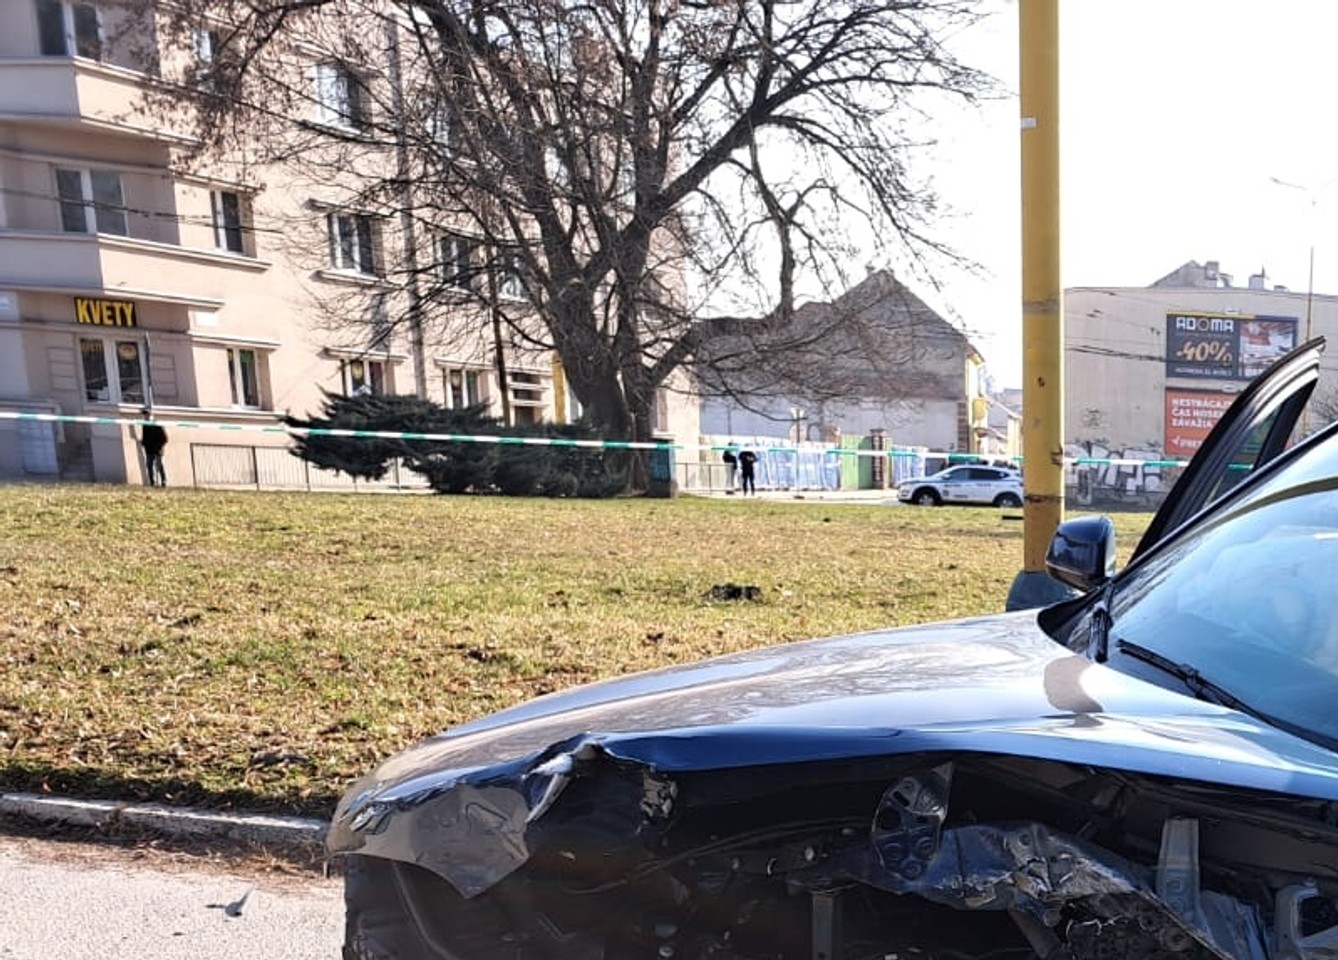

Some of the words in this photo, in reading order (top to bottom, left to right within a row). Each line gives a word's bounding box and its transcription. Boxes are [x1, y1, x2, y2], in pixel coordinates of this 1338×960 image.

[76, 298, 134, 327] KVETY
[1175, 317, 1235, 332] ADOMA
[1175, 340, 1233, 367] -40%
